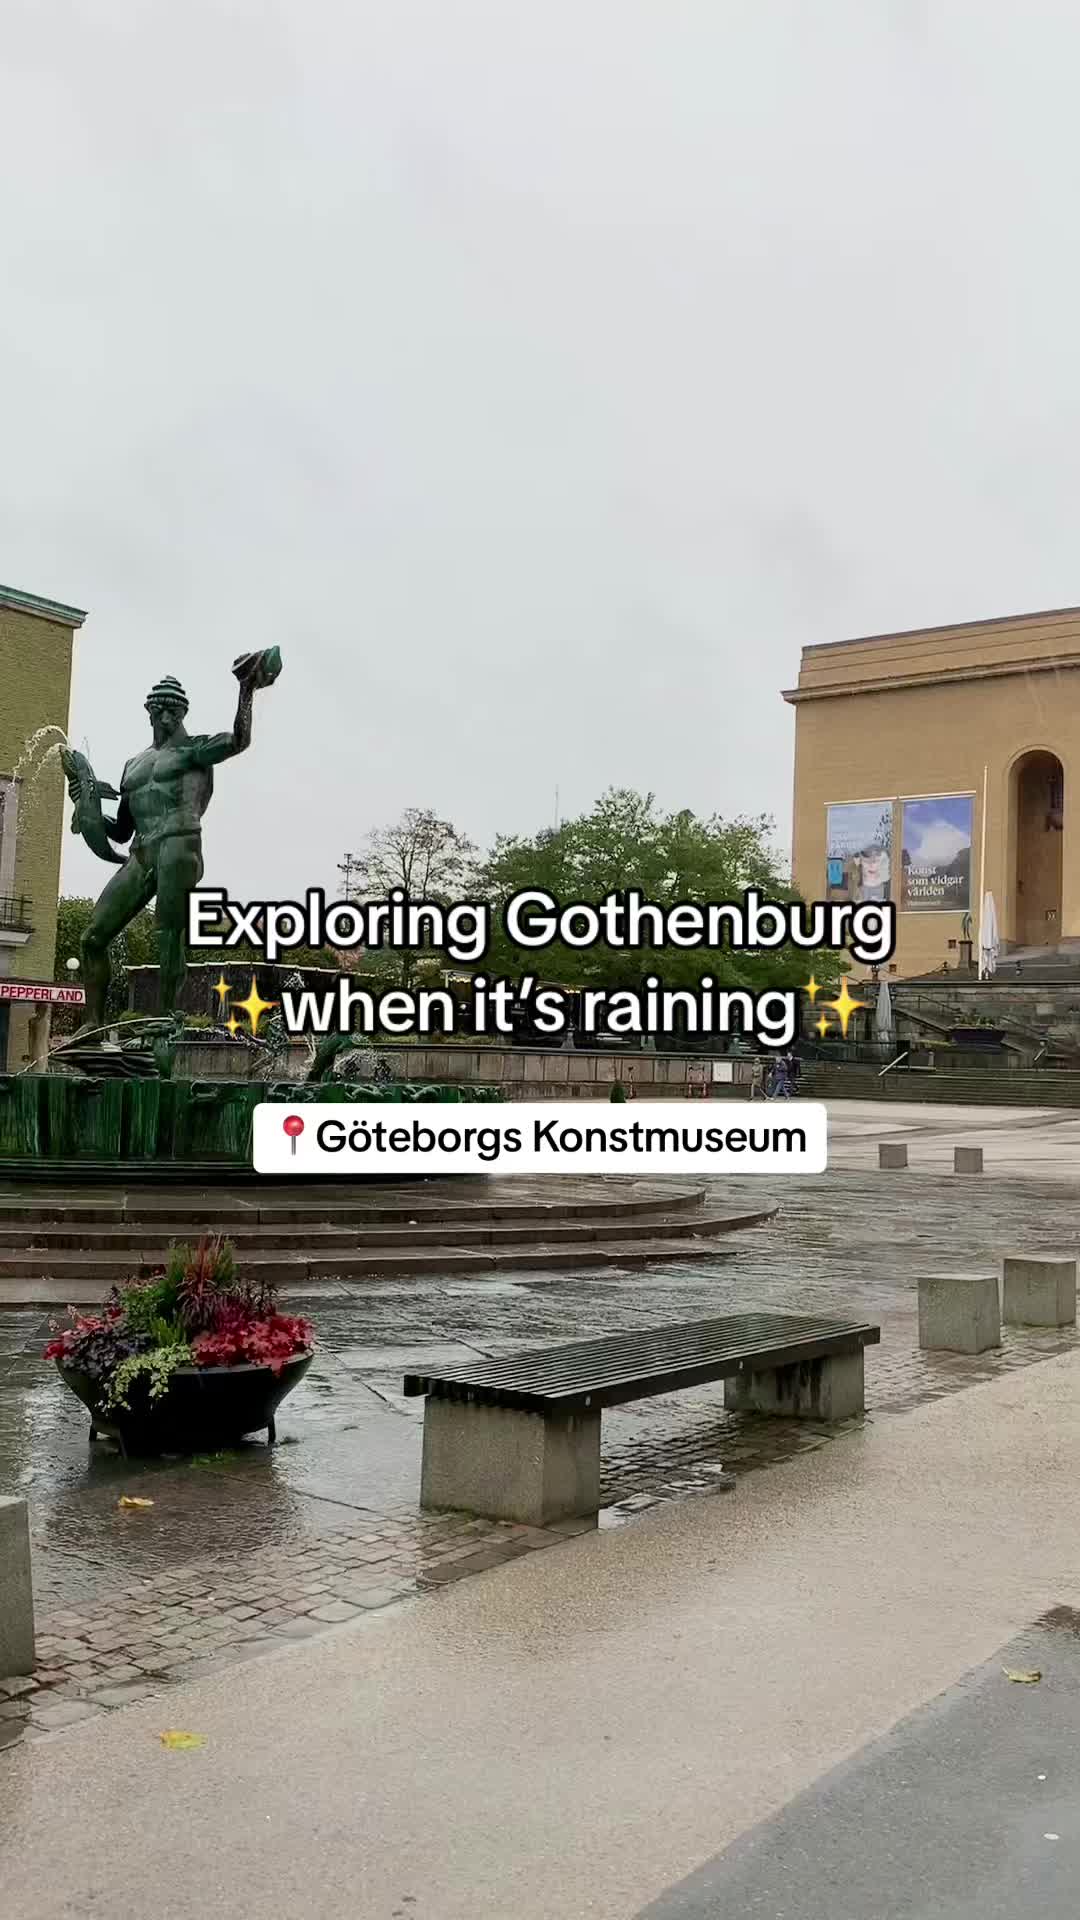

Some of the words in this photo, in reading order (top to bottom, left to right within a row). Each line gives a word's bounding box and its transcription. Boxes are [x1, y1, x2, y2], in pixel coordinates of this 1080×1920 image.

[907, 878, 928, 886] som
[930, 874, 965, 887] vidgar
[907, 886, 945, 896] världen
[1, 985, 83, 1001] PEPPERLAND
